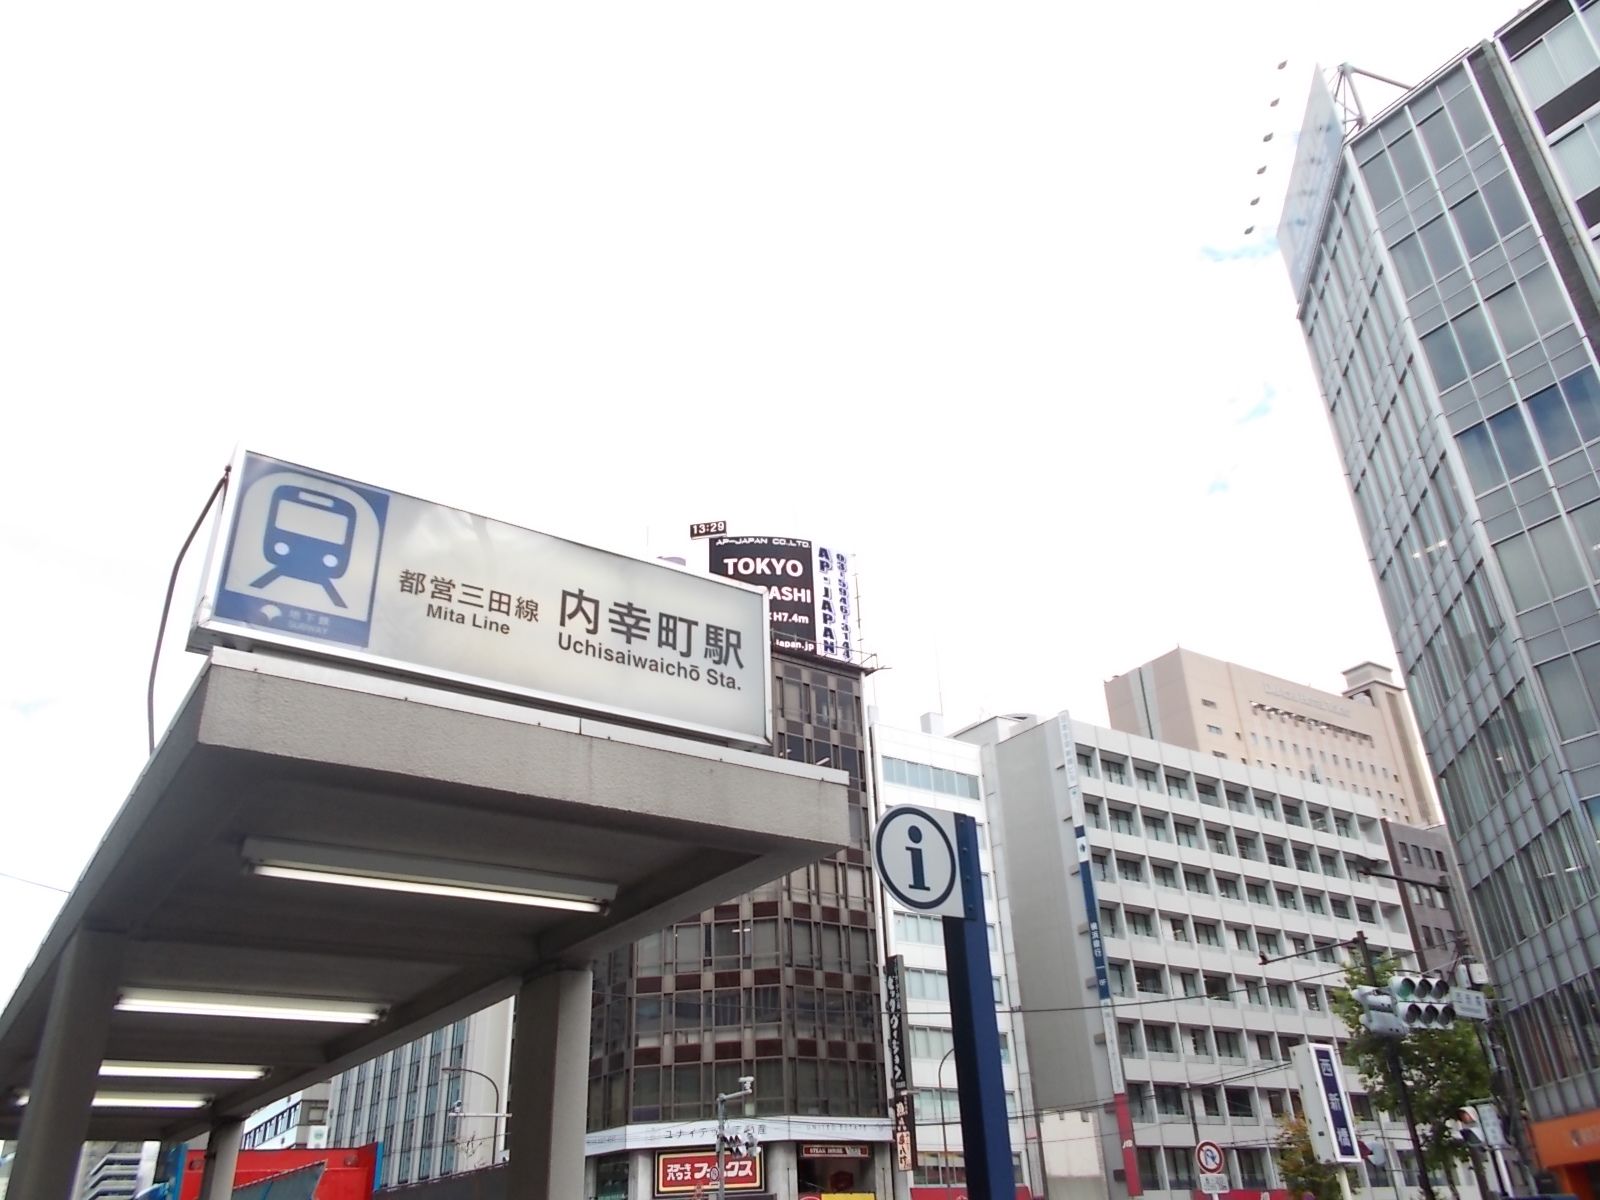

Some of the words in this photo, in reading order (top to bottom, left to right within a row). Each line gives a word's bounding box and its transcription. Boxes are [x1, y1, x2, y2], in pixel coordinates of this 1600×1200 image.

[693, 521, 725, 535] 13:29
[723, 557, 804, 578] TOKYO
[399, 569, 539, 623] 都営三田線
[766, 585, 812, 604] ASHI
[426, 603, 466, 625] Mita
[472, 613, 511, 635] Line
[559, 588, 744, 669] 内幸町駅
[558, 631, 701, 682] Uchisaiwaichō
[706, 668, 742, 691] Sta.
[1318, 1058, 1352, 1147] 西新橋
[667, 1163, 692, 1173] ステーキ
[667, 1172, 692, 1181] ハウス
[694, 1160, 753, 1180] フクス
